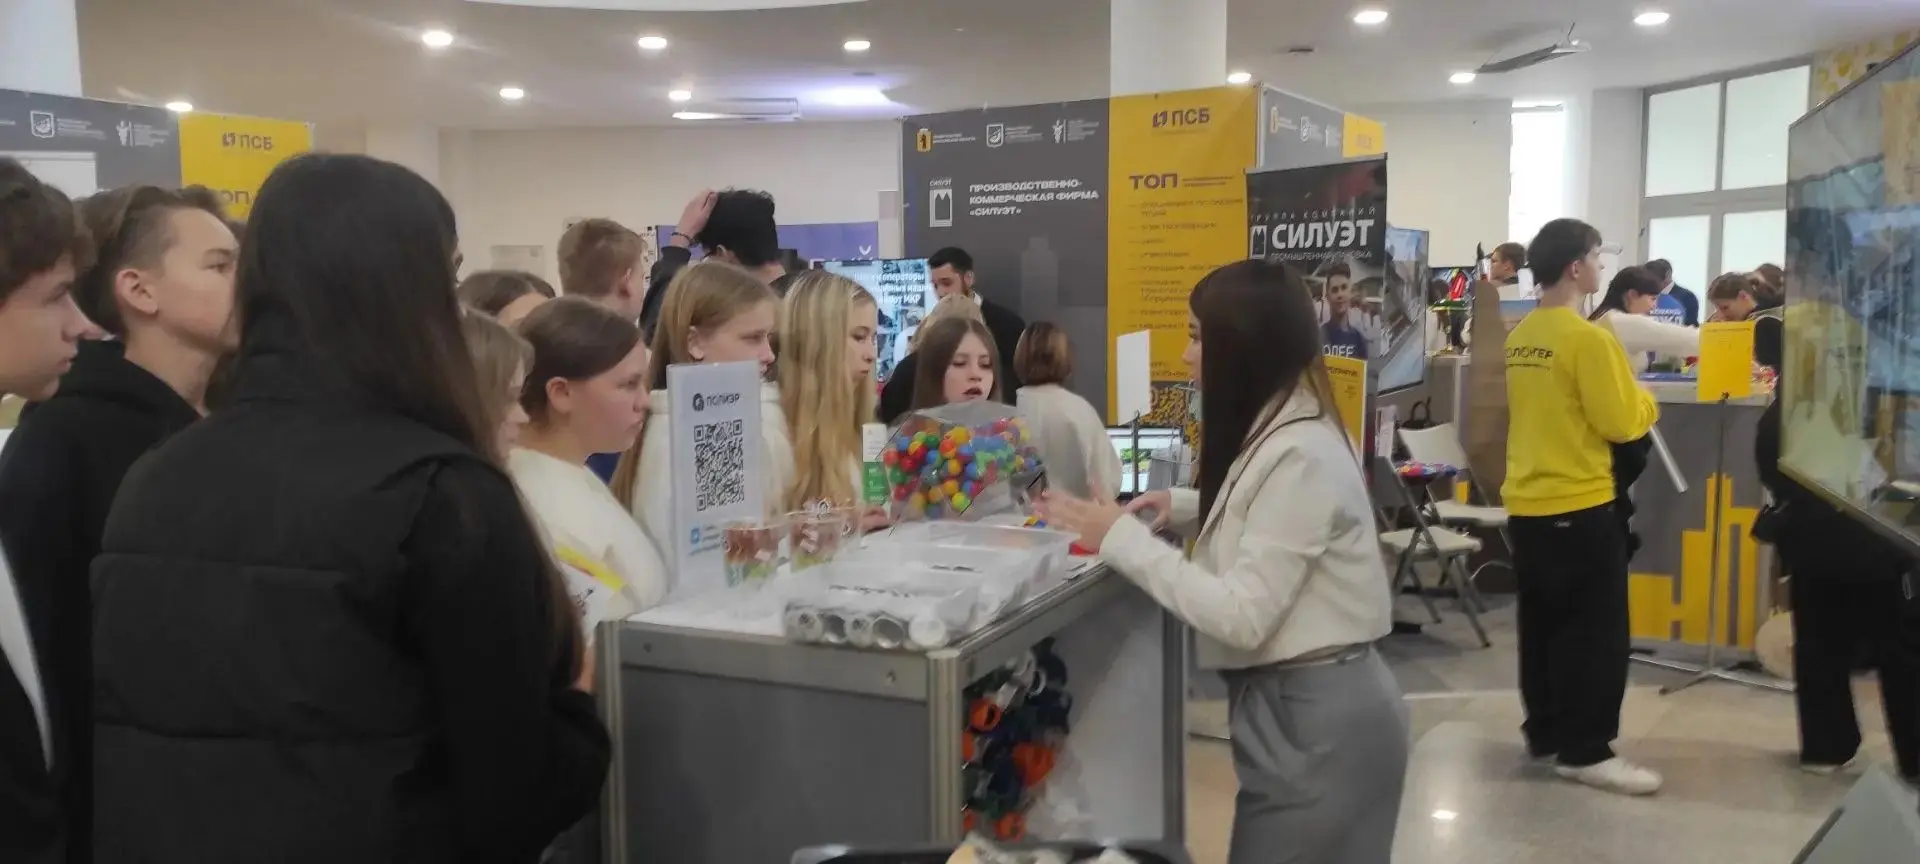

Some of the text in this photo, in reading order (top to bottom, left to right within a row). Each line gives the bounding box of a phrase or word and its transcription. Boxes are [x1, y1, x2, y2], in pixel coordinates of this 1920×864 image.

[1172, 108, 1210, 126] ПСБ
[240, 134, 274, 151] ПСБ
[969, 179, 1083, 193] ПРОИЗВОДСТВЕННО-
[1129, 173, 1178, 190] ТОП
[969, 190, 1100, 206] КОММЕРЧЕСКАЯ ФИРМА
[969, 206, 1022, 216] «СИЛУЭТ»
[1271, 219, 1375, 250] СИЛУЭТ
